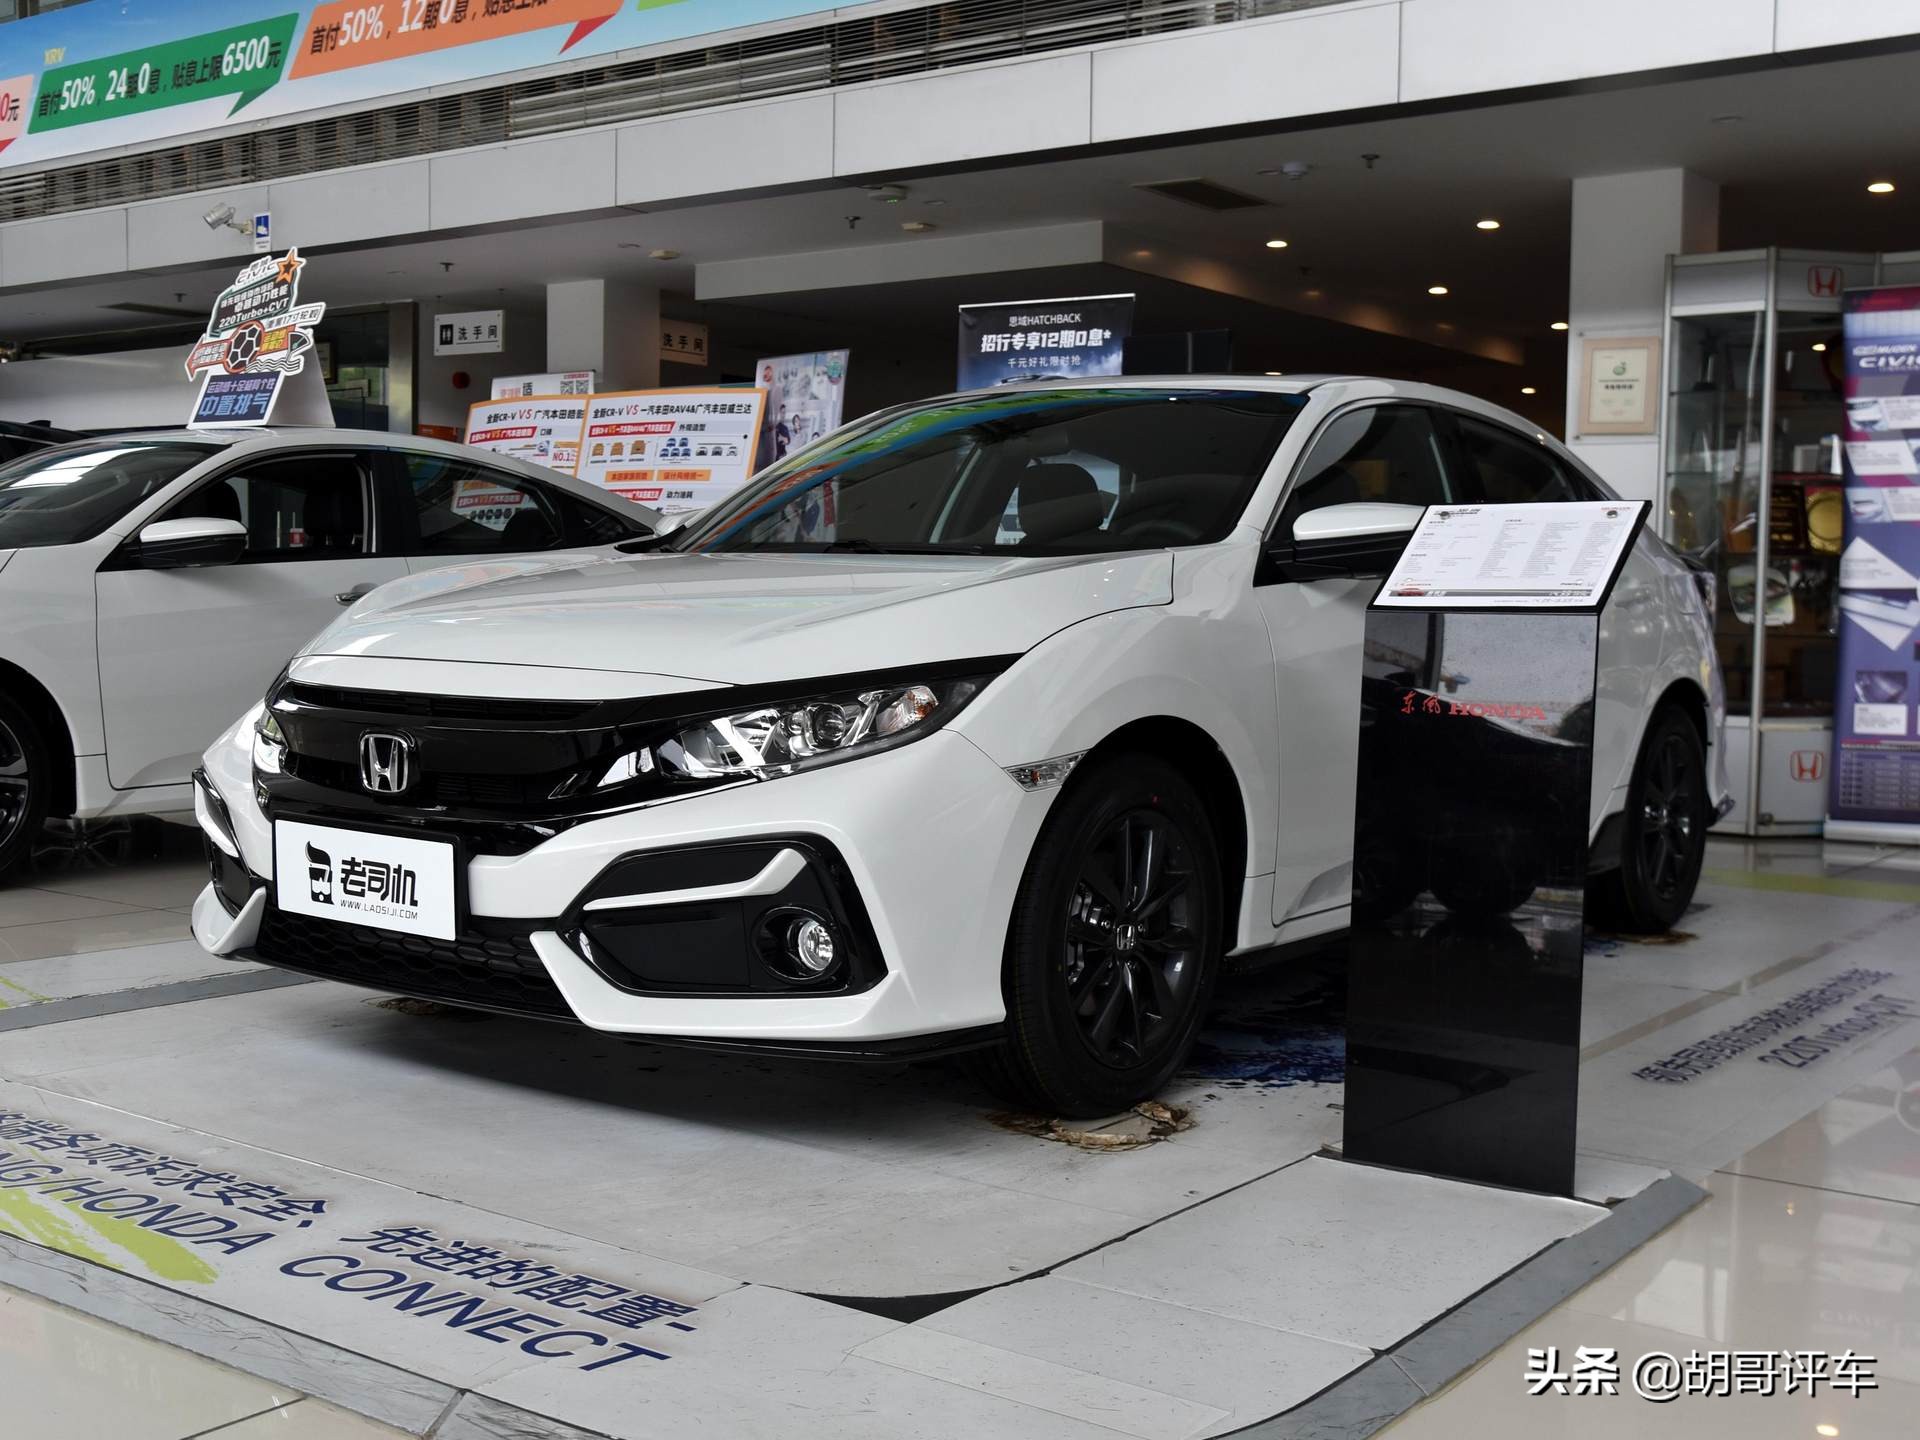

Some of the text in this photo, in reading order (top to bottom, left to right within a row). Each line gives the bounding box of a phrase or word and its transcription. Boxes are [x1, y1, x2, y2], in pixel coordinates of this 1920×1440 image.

[219, 298, 290, 328] 220Turbo+CVT
[1008, 313, 1082, 327] 思域HATCHBACK
[458, 324, 498, 341] 洗手间
[662, 333, 704, 352] 洗手间
[1008, 355, 1081, 369] 千元好礼限时抢
[199, 393, 271, 416] 中置排气
[625, 404, 639, 416] VS
[519, 408, 533, 420] VS
[1448, 702, 1548, 720] HONDA
[340, 856, 419, 907] 老司机
[340, 899, 418, 920] WWW.LAOSIJI.COM
[278, 1255, 672, 1371] CONNECT
